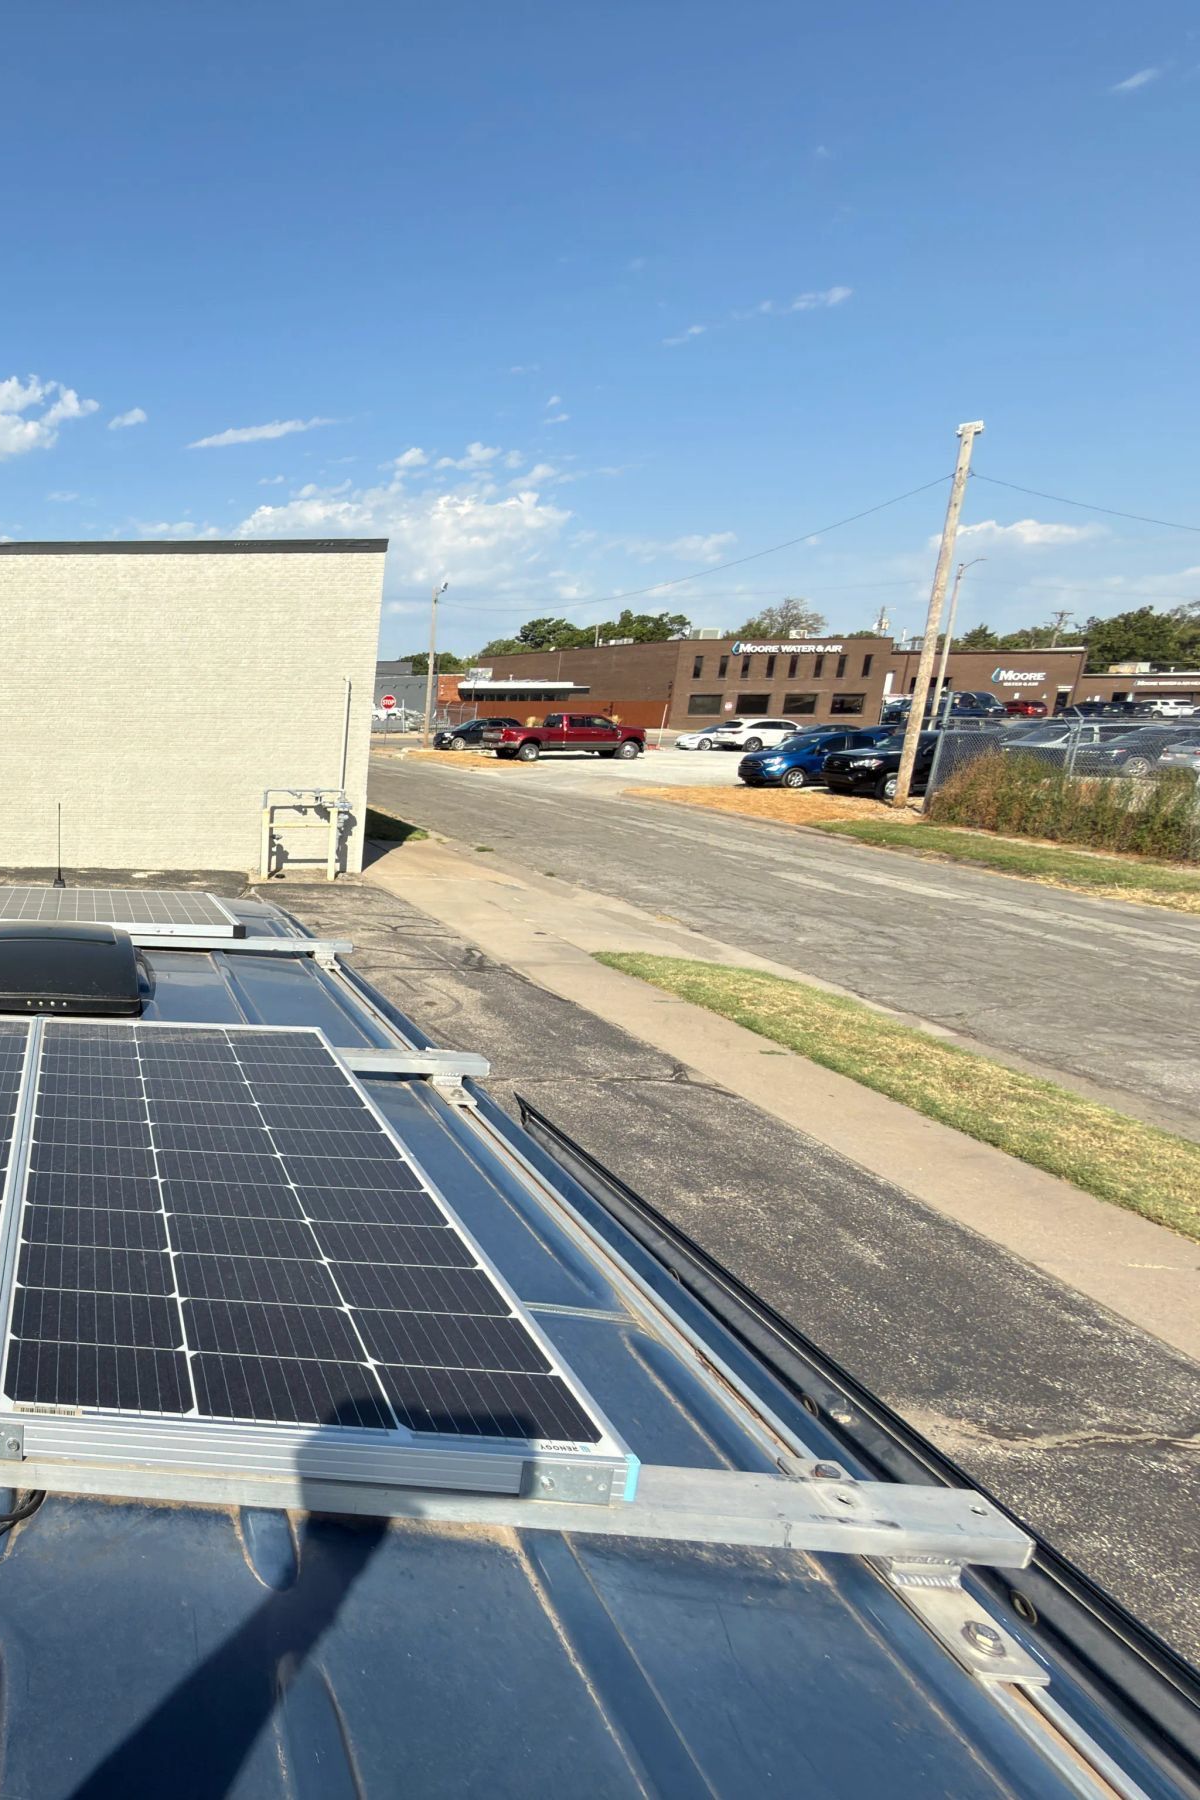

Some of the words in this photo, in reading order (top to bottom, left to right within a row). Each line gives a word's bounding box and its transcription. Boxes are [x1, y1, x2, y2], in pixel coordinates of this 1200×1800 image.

[739, 643, 780, 653] MOORE
[780, 644, 816, 653] WATER
[999, 670, 1047, 681] MOORE
[540, 1444, 580, 1452] RENOGY
